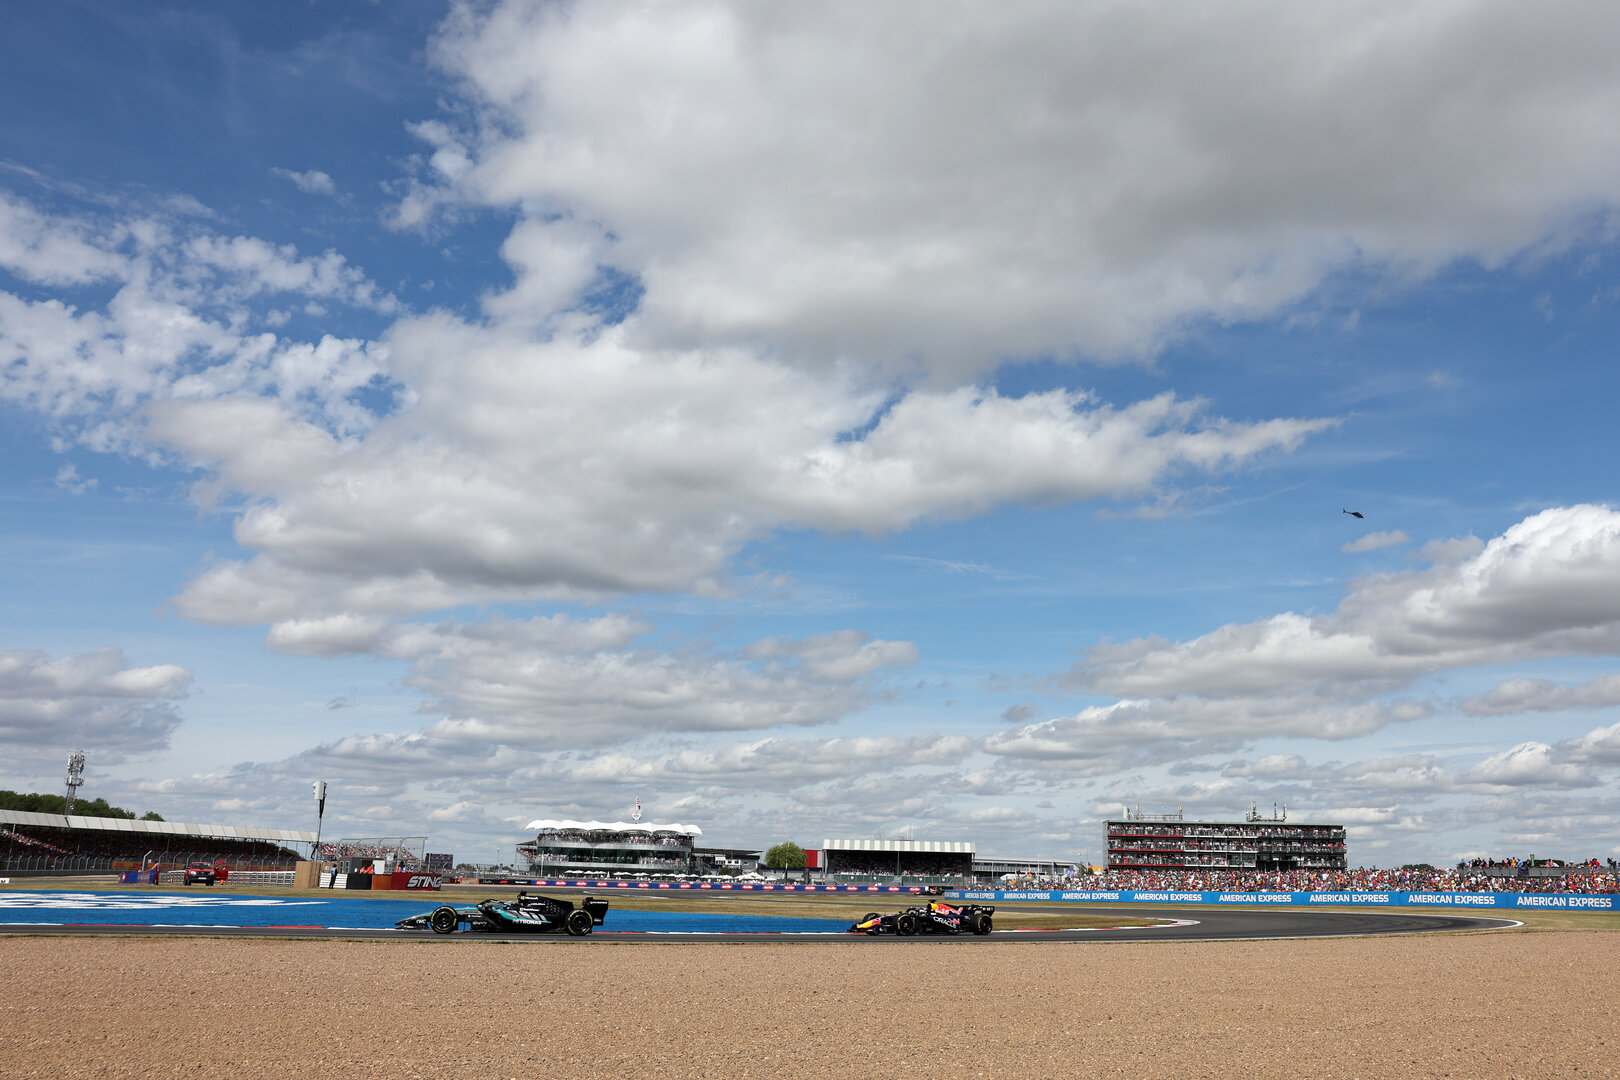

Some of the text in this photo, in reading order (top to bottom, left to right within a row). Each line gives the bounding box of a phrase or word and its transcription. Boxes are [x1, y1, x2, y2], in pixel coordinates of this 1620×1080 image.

[406, 875, 442, 888] STING
[1003, 892, 1050, 900] AMERICAN EXPRESS
[1061, 892, 1090, 900] AMERICAN
[1133, 893, 1203, 901] AMERICAN EXPRESS
[1218, 894, 1292, 902] AMERICAN EXPRESS
[1309, 894, 1390, 903] AMERICAN EXPRESS
[1408, 894, 1496, 905] AMERICAN EXPRESS
[1516, 896, 1613, 908] AMERICAN EXPRESS
[933, 916, 958, 929] ORACLE
